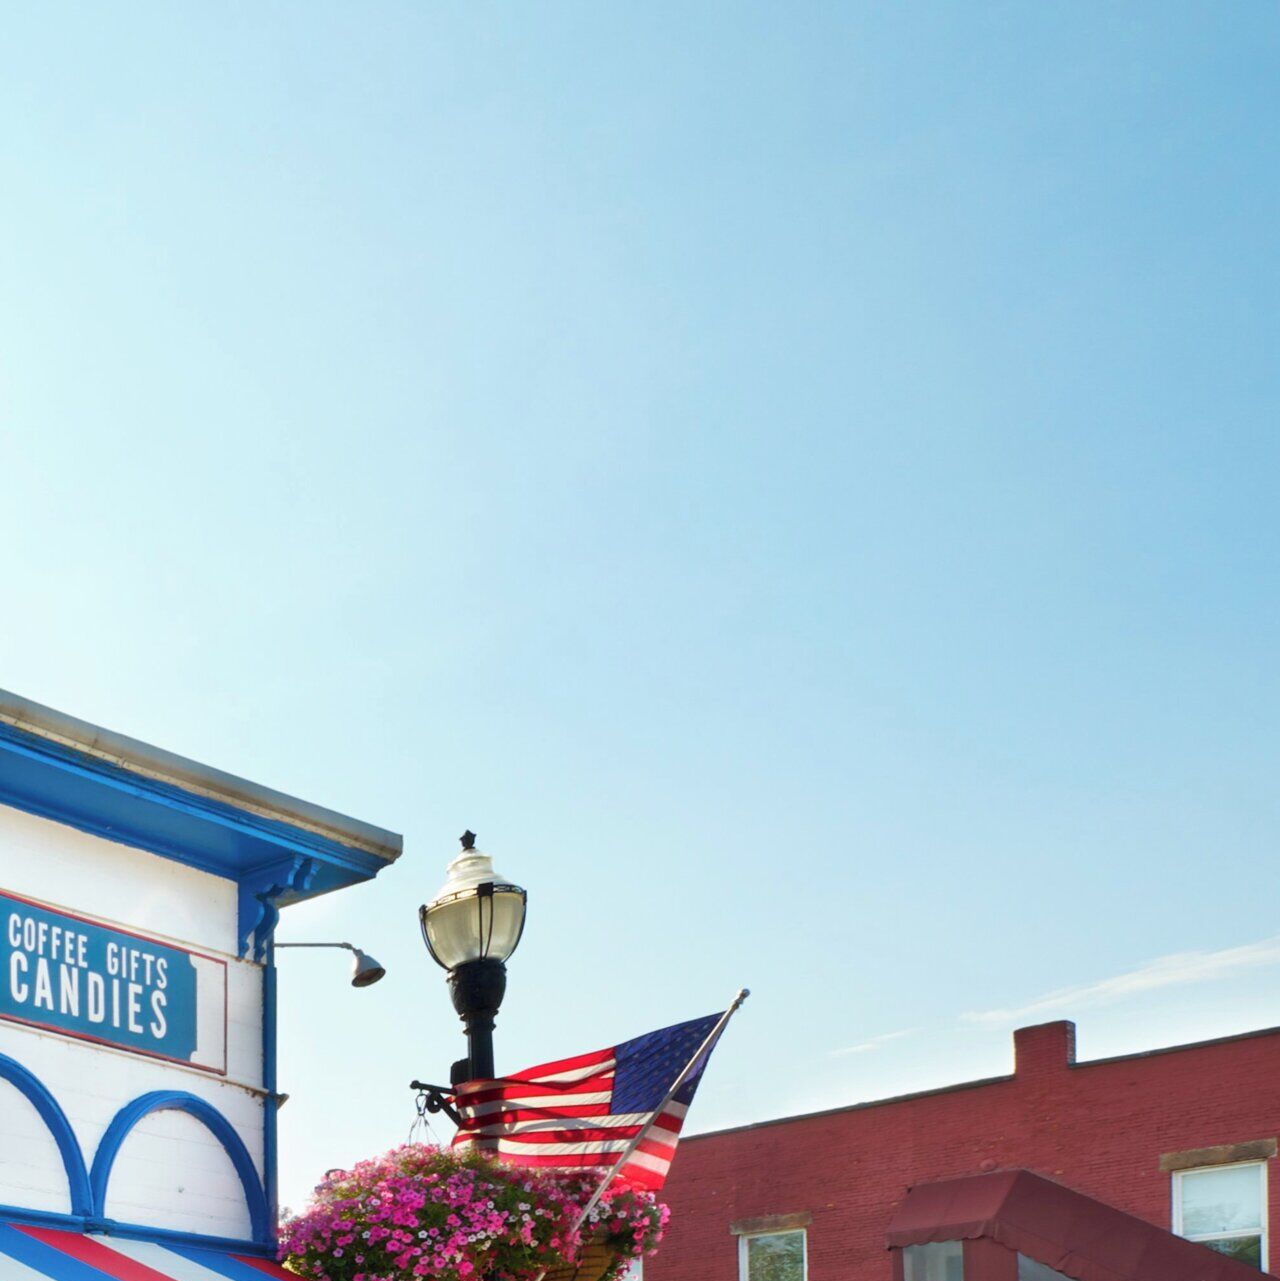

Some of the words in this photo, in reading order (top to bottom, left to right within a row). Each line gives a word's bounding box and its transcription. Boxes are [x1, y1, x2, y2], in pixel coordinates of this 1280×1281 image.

[8, 912, 89, 968] COFFEE
[106, 941, 168, 990] GIFTS
[9, 950, 168, 1039] CANDIES
